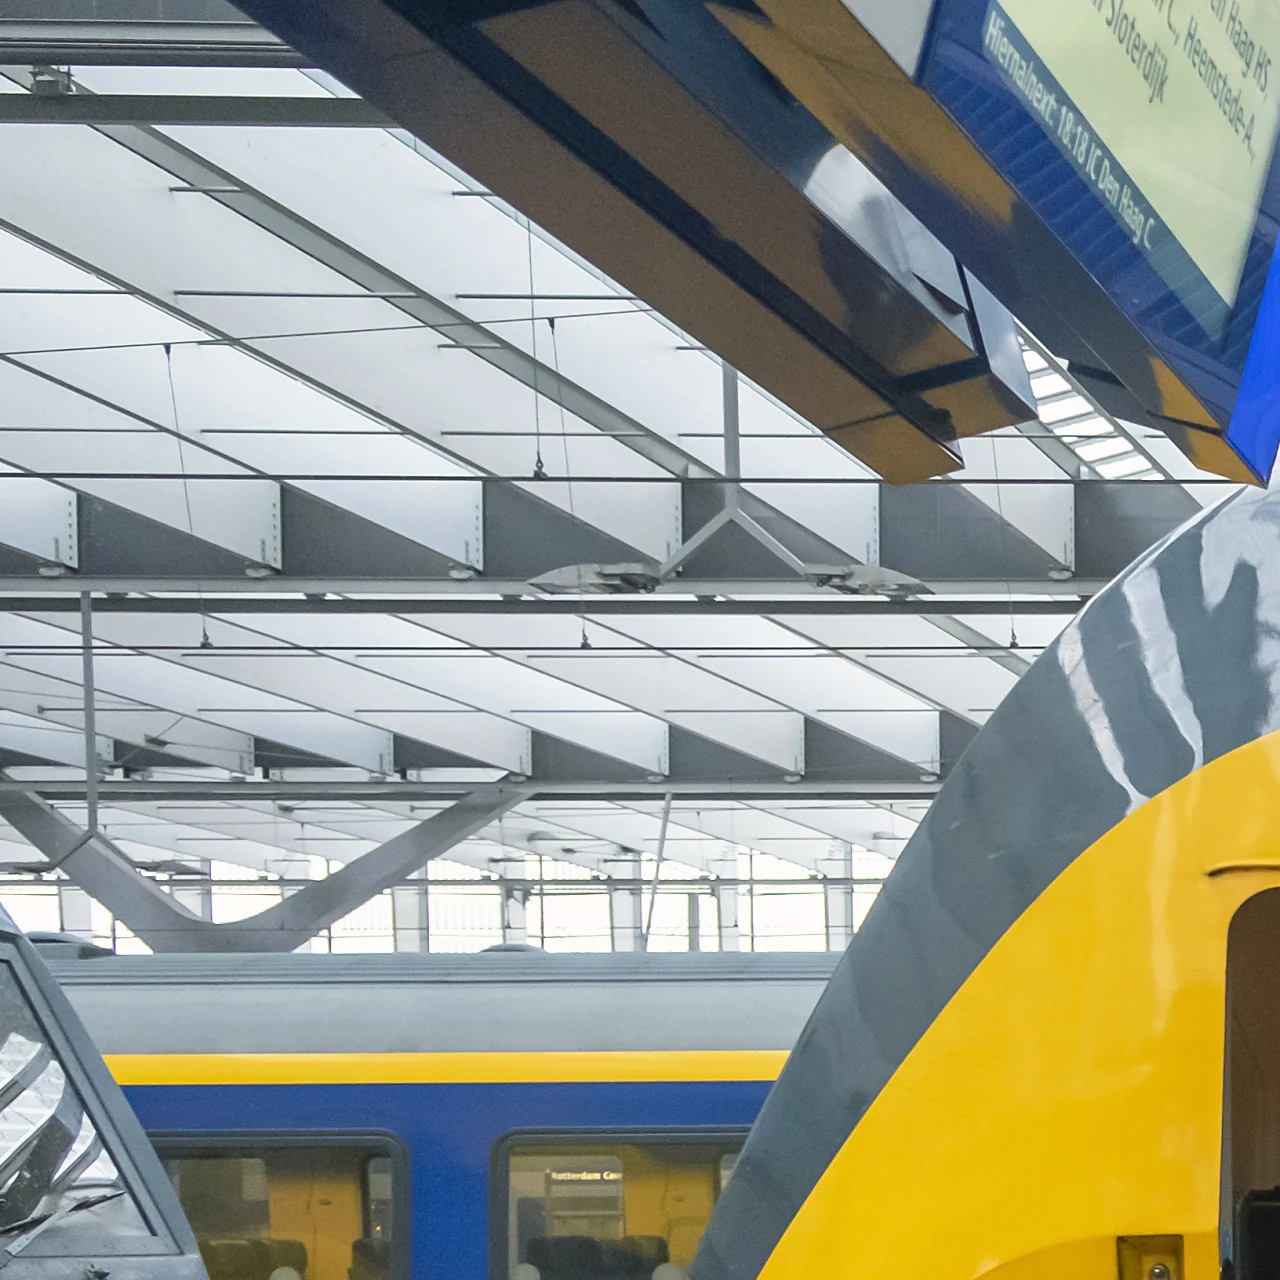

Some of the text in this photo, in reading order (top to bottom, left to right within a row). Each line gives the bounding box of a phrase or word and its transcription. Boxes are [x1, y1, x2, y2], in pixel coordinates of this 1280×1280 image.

[1105, 0, 1168, 104] Sloterdijk
[1226, 0, 1254, 78] Haag
[1058, 105, 1089, 164] 18:18
[1086, 142, 1103, 181] IC
[1098, 158, 1120, 208] Den
[1119, 184, 1144, 244] Haag
[1144, 217, 1155, 251] C
[551, 1171, 601, 1180] Rotterdam
